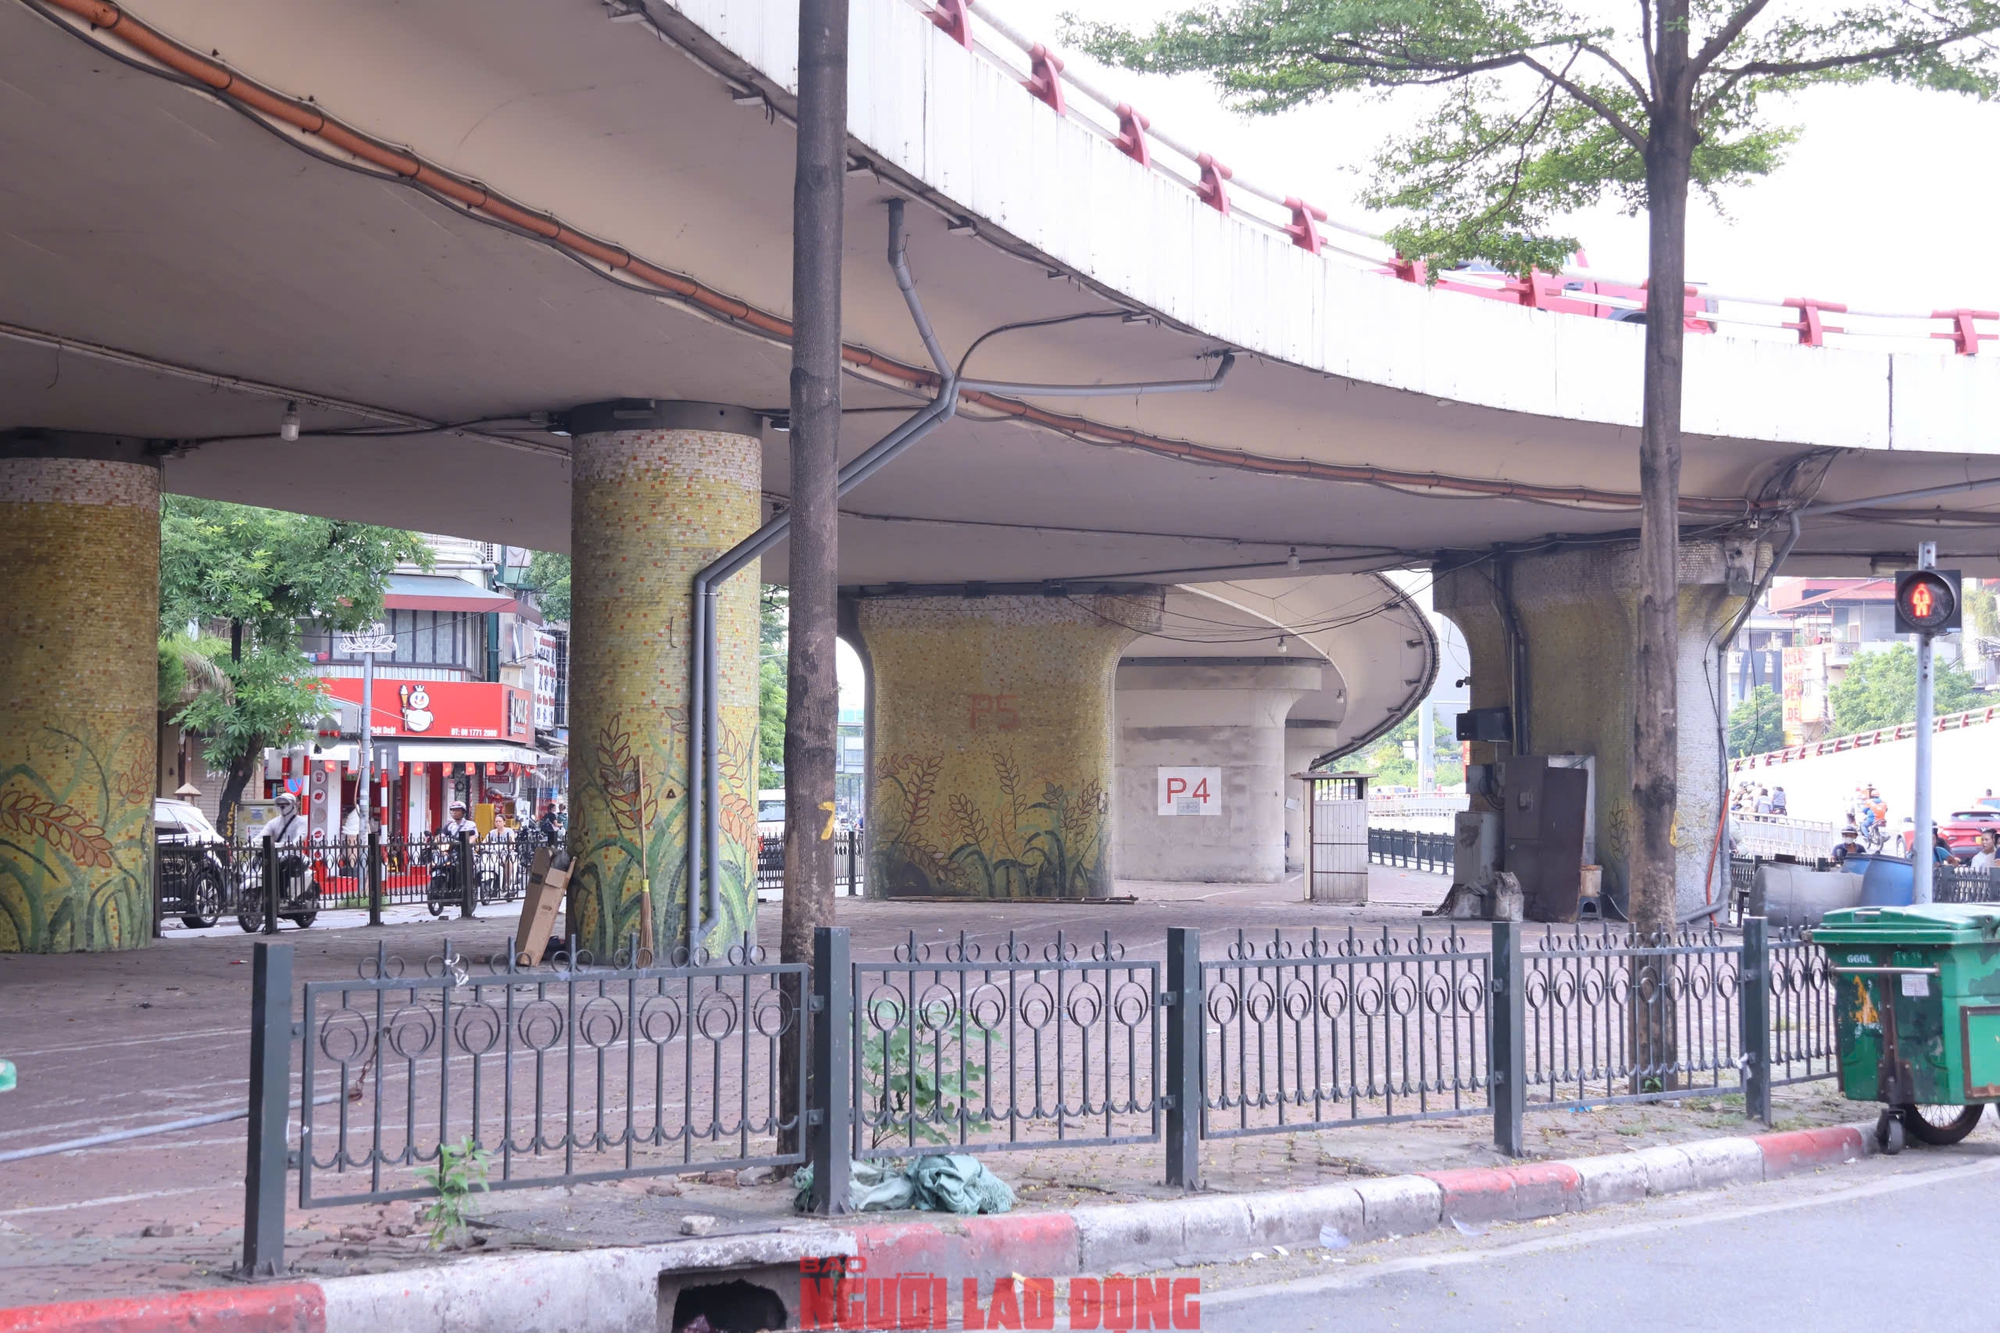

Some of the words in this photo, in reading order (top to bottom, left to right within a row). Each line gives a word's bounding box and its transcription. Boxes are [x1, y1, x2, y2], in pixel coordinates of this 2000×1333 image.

[970, 694, 1018, 730] P5
[1167, 777, 1210, 804] P4
[1847, 954, 1872, 964] 660L
